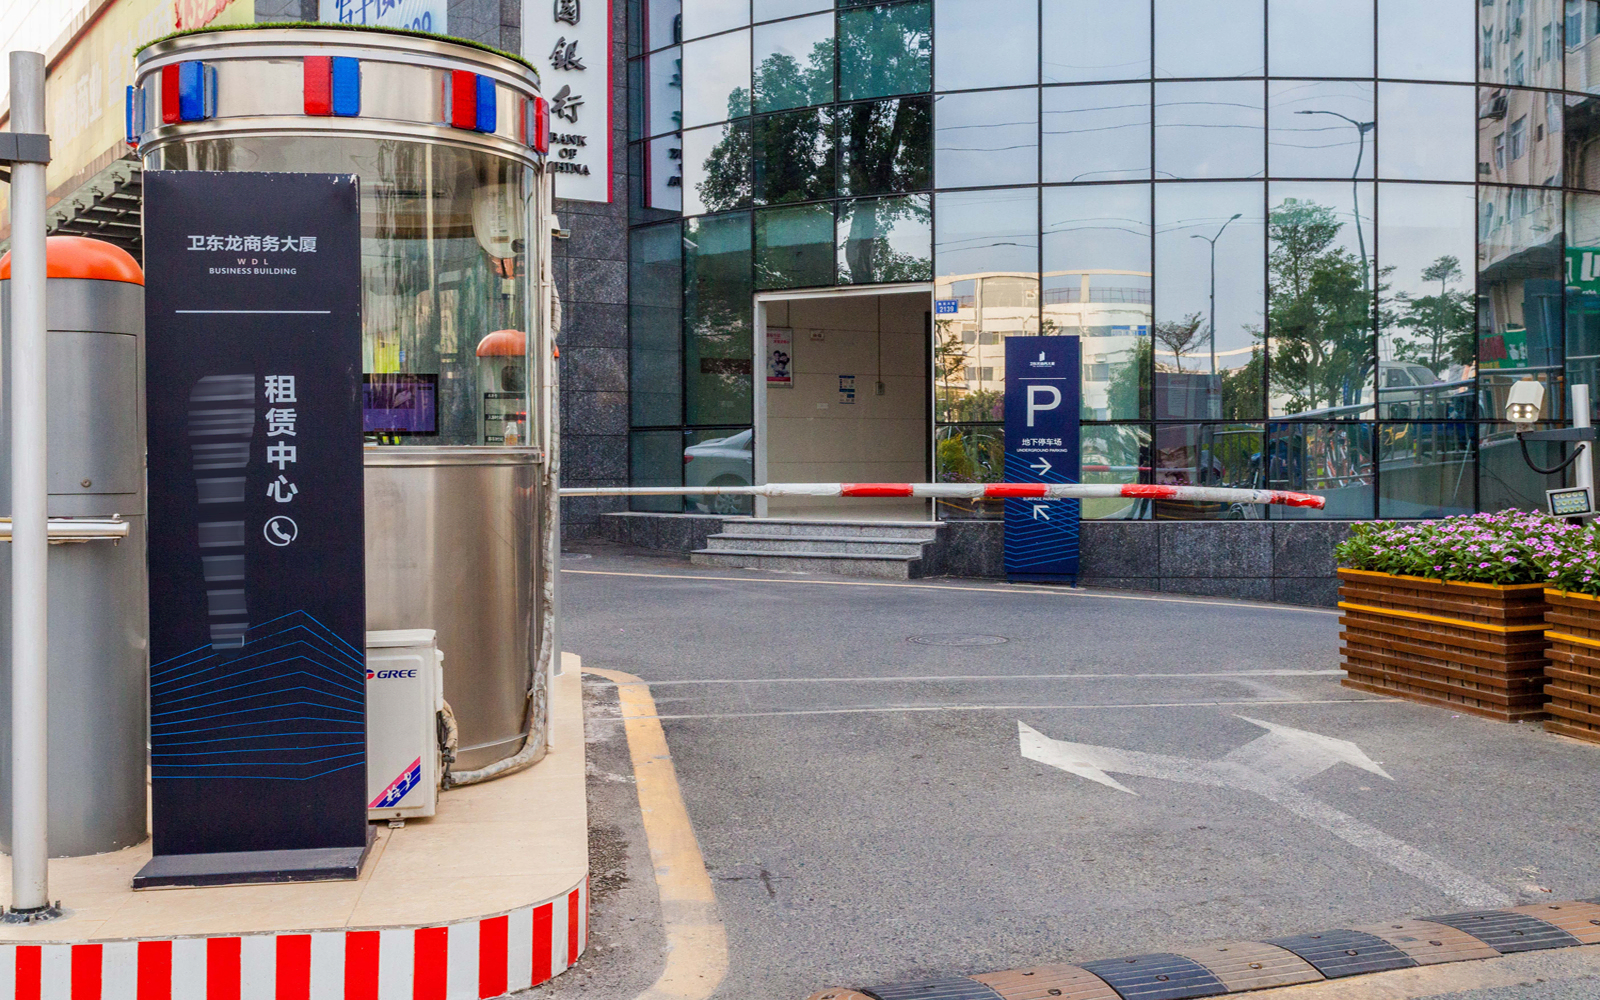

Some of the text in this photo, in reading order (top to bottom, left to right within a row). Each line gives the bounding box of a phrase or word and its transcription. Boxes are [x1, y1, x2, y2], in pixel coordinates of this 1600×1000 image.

[549, 132, 587, 146] BANK
[558, 148, 577, 159] OF
[187, 235, 317, 253] 卫东龙商务大厦
[209, 267, 252, 275] BUSINESS
[1026, 385, 1062, 427] P
[264, 375, 298, 503] 租赁中心
[1022, 438, 1062, 446] 地下停车场
[377, 669, 417, 679] GREE
